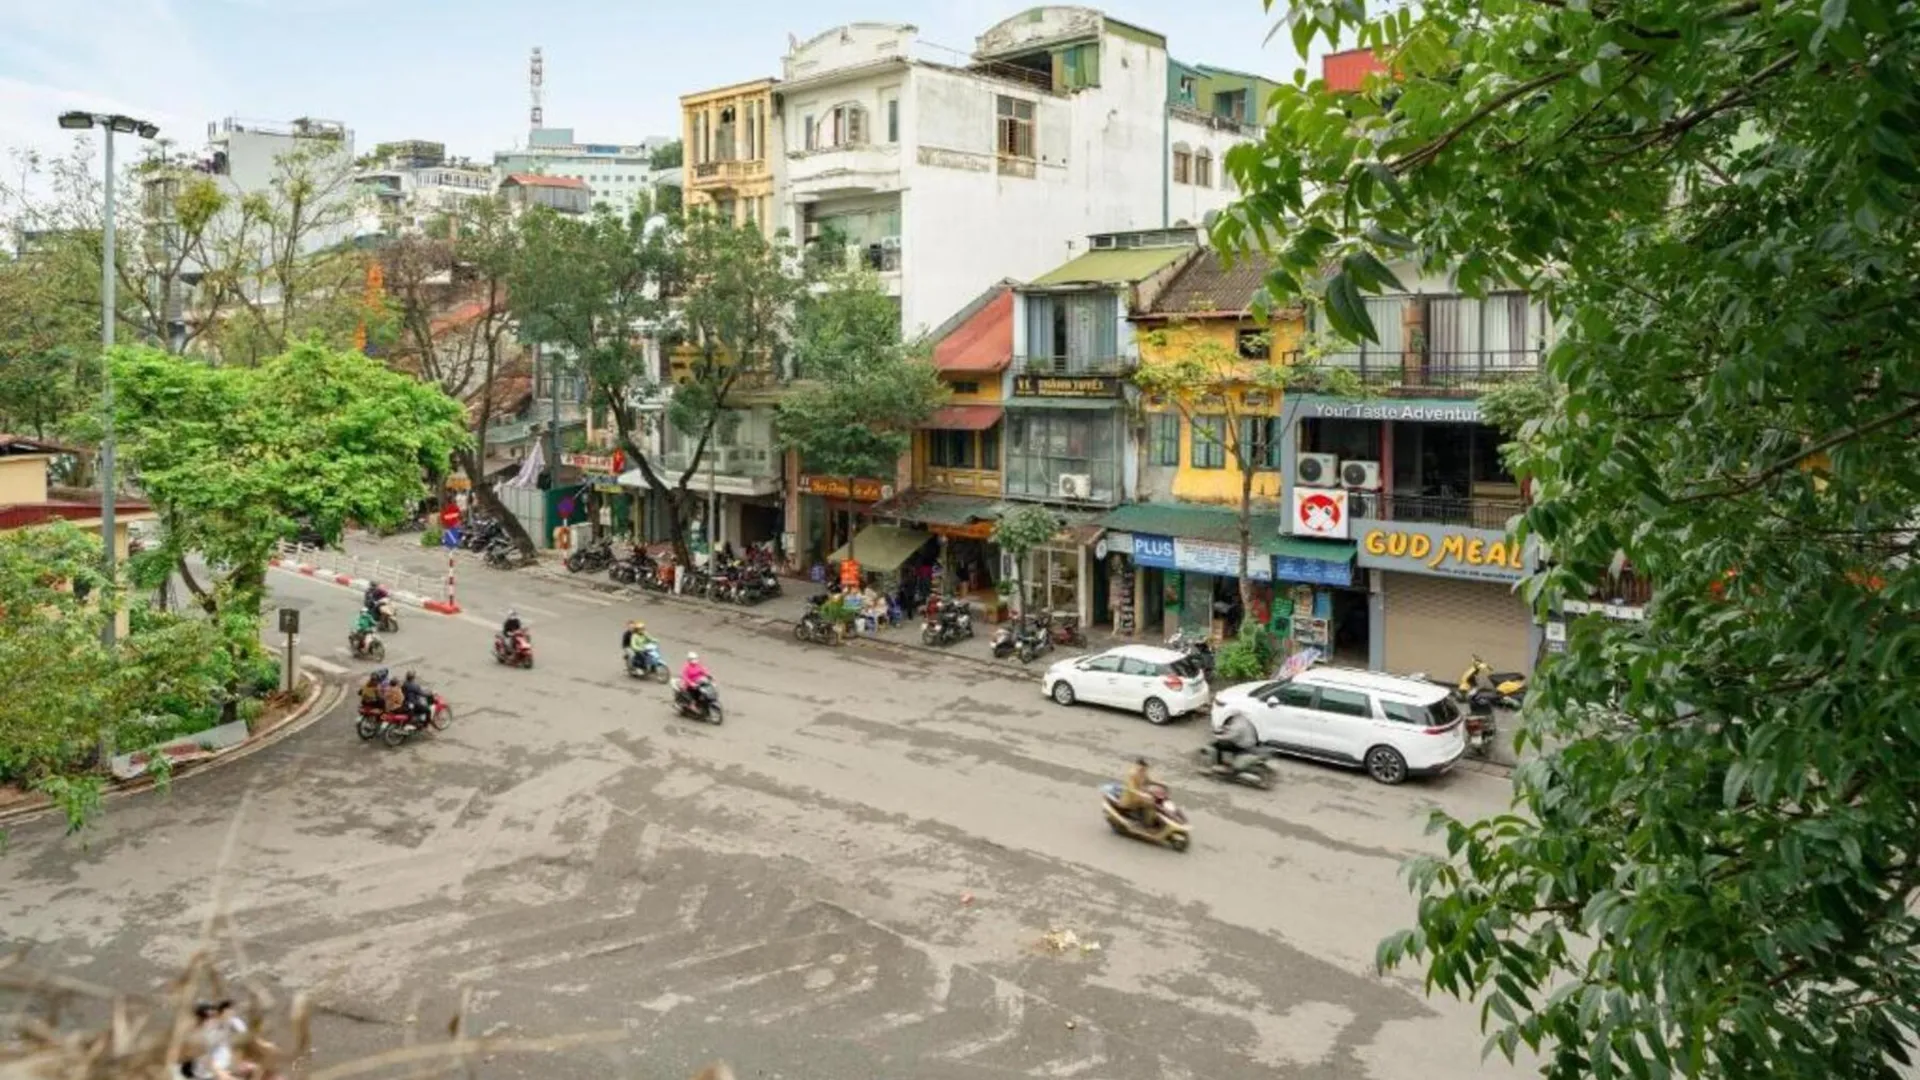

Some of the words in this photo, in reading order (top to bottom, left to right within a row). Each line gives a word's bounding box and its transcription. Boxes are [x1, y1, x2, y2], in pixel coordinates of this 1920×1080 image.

[1315, 403, 1350, 418] Your
[1352, 403, 1397, 420] Taste
[1135, 538, 1173, 557] PLUS
[1365, 528, 1431, 558] GUD
[1427, 533, 1524, 570] MEAL
